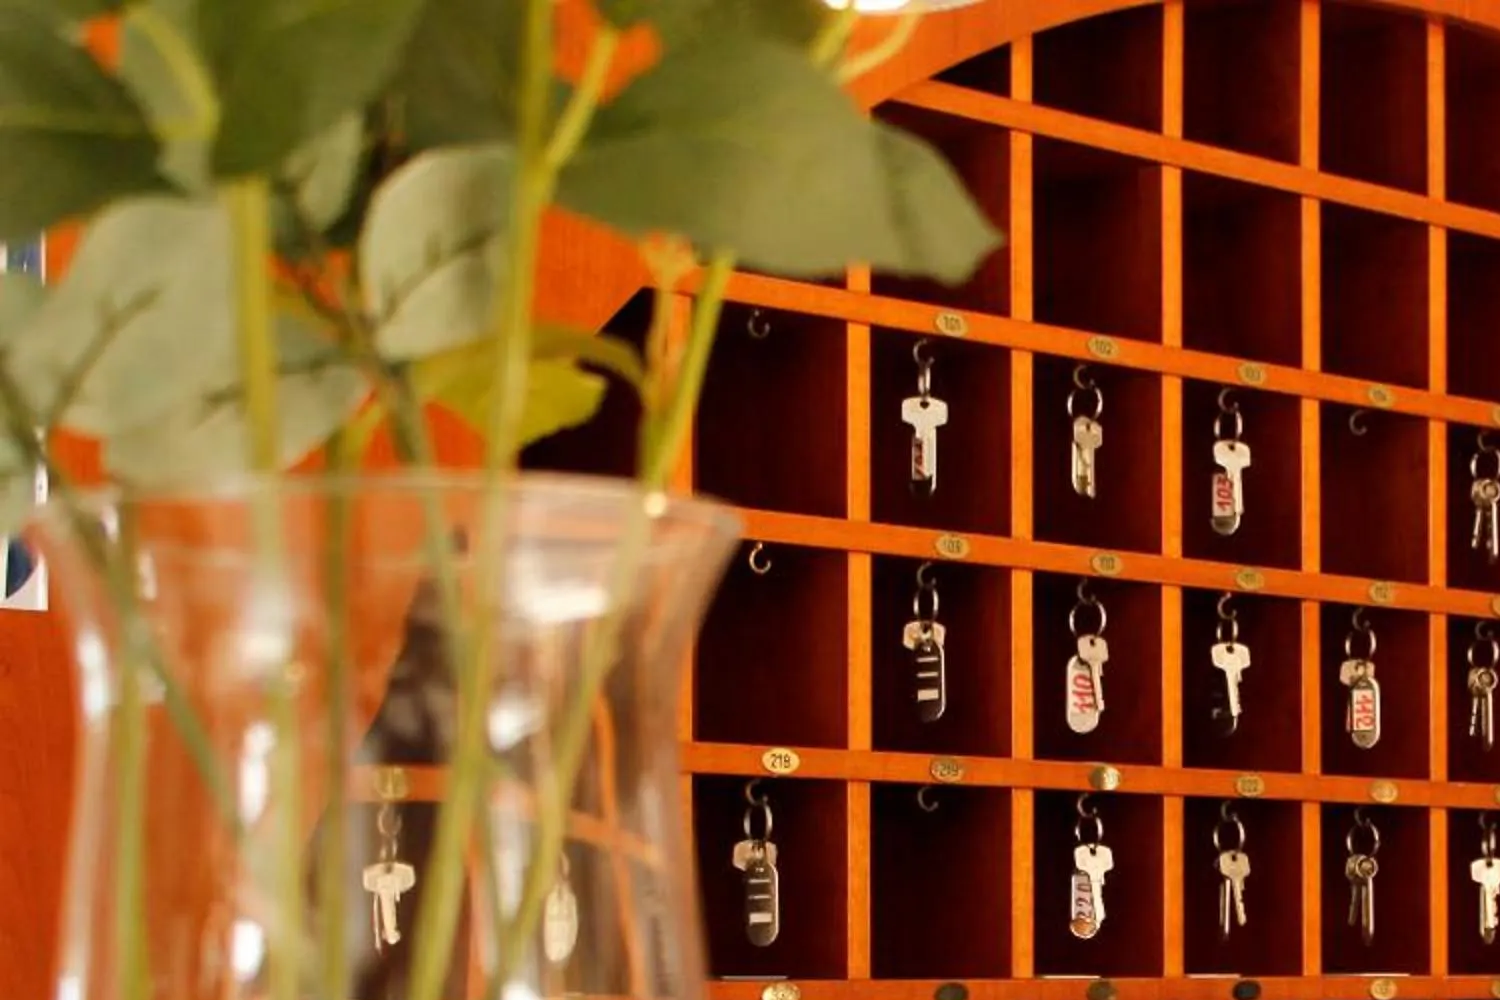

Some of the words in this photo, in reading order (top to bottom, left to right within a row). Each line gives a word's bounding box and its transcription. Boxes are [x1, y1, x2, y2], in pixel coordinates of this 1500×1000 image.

[1072, 673, 1093, 713] 110
[1355, 695, 1377, 730] 112
[770, 753, 791, 769] 218
